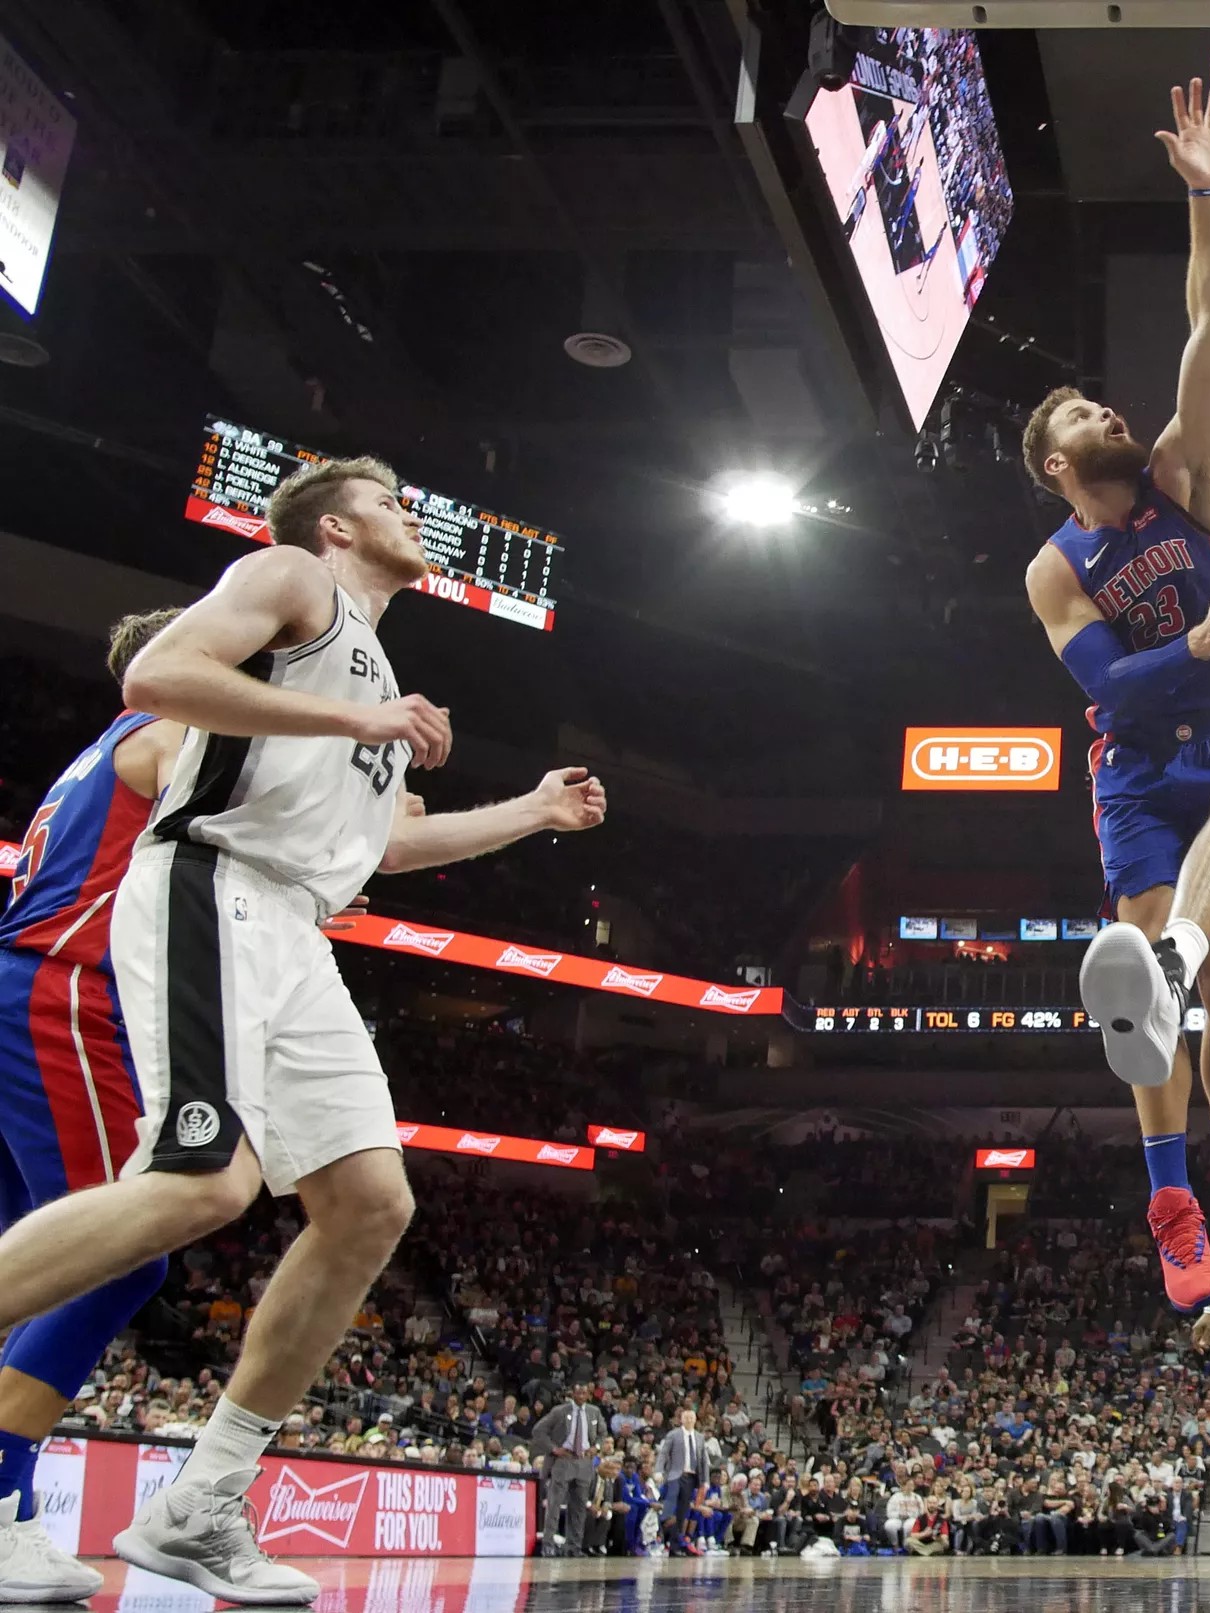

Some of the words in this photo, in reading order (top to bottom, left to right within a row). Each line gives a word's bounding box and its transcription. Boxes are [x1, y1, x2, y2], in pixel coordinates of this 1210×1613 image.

[235, 440, 268, 459] WHITE
[228, 462, 278, 486] ALDRIDGE
[232, 451, 280, 475] DEROZAN
[429, 494, 454, 511] DET
[423, 503, 478, 530] DRUMMOND
[427, 573, 469, 605] YOU.
[1093, 539, 1194, 623] DETROIT
[1128, 584, 1185, 652] 23
[930, 747, 1040, 771] H-E-B
[815, 1017, 834, 1030] 20
[846, 1017, 855, 1030] 7
[869, 1017, 880, 1030] 2
[893, 1017, 904, 1030] 3
[926, 1012, 958, 1028] TOL
[967, 1012, 980, 1028] 6
[991, 1012, 1015, 1028] FG
[1020, 1012, 1061, 1028] 42%
[1073, 1012, 1085, 1028] F
[270, 1482, 359, 1522] Budweiser
[377, 1472, 411, 1510] THIS
[414, 1475, 456, 1513] BUD'S
[375, 1513, 407, 1550] FOR
[408, 1514, 442, 1551] YOU.
